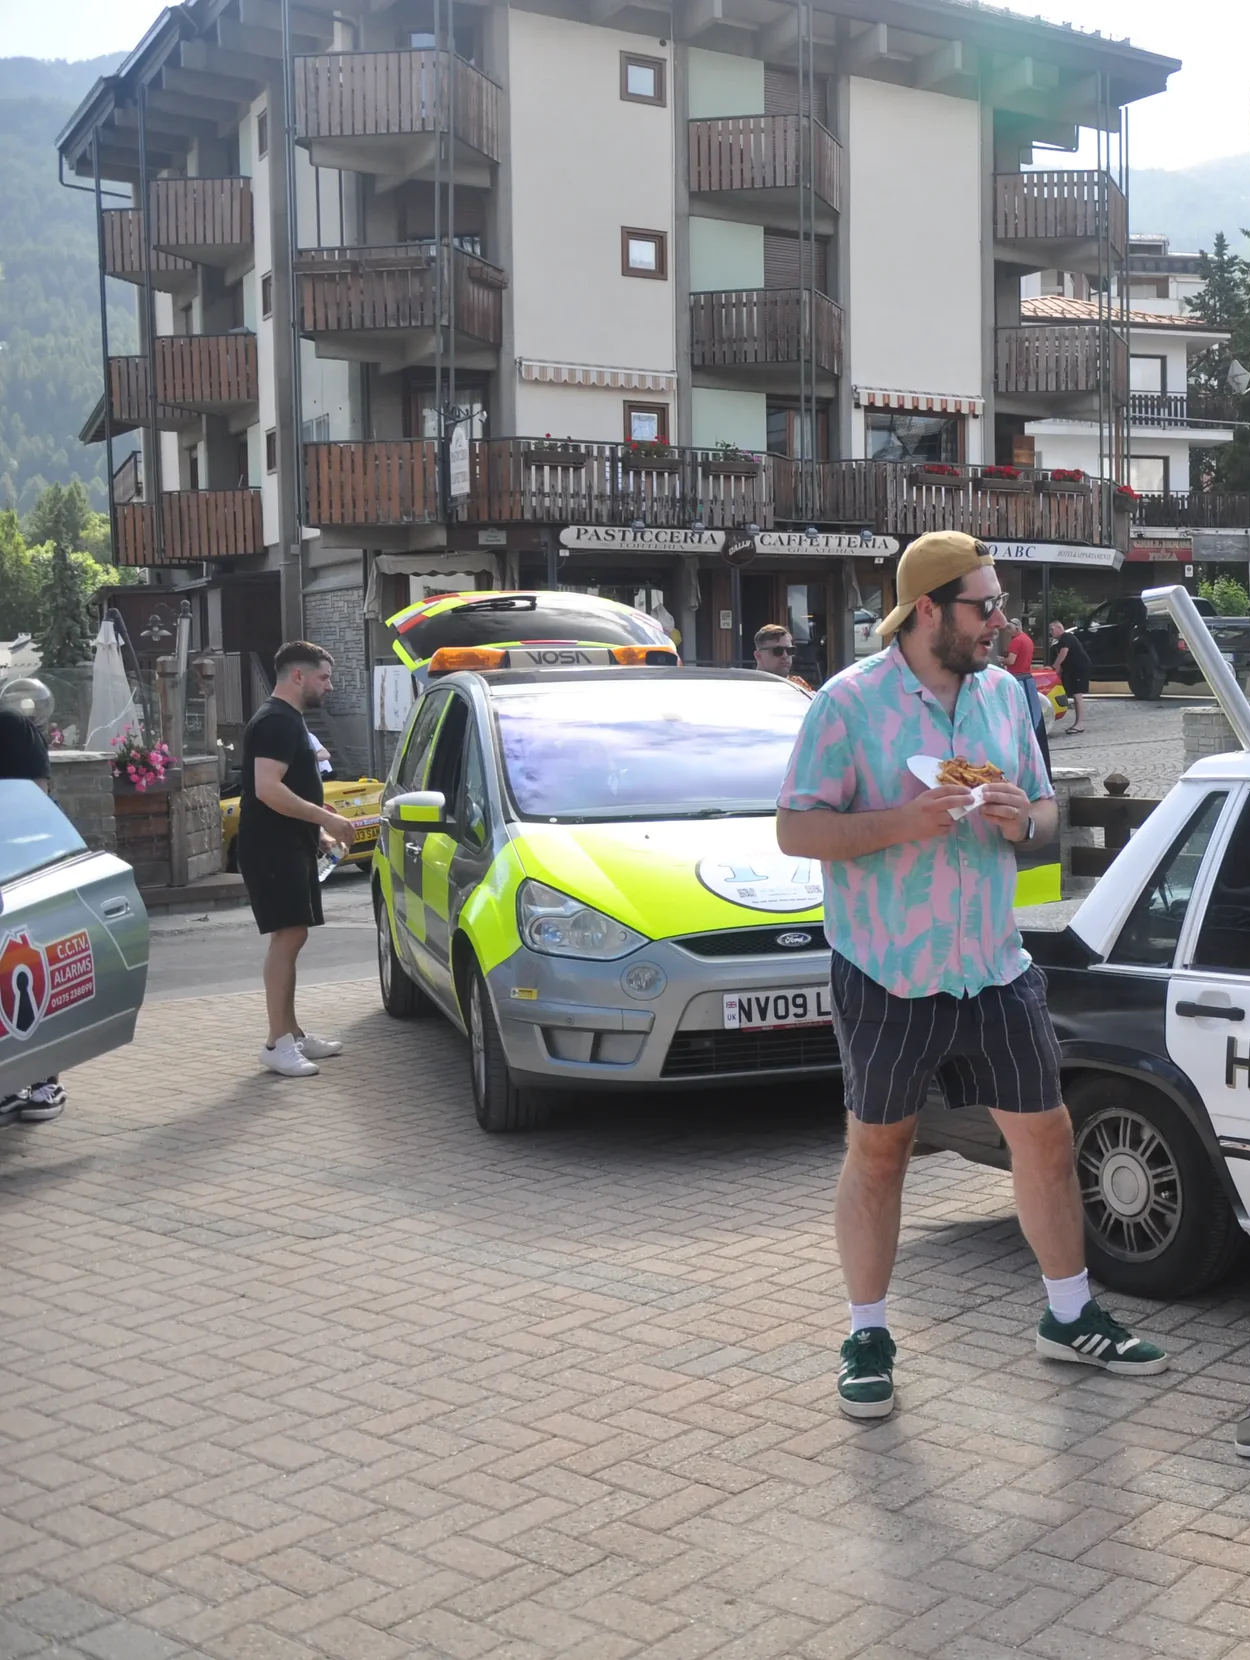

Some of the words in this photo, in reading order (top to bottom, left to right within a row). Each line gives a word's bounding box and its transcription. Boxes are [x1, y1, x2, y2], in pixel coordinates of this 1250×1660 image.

[574, 527, 718, 545] PASTICCERIA
[759, 533, 889, 550] CAFFETTERIA
[619, 542, 685, 550] TORTERIA
[1002, 545, 1036, 558] ABC
[525, 651, 592, 664] VOSA
[57, 935, 89, 959] C.C.T.V.
[784, 935, 804, 944] Ford
[54, 957, 92, 986] ALARMS
[51, 992, 70, 1008] 01275
[739, 993, 808, 1023] NV09
[816, 991, 832, 1017] L
[727, 1013, 737, 1021] UK
